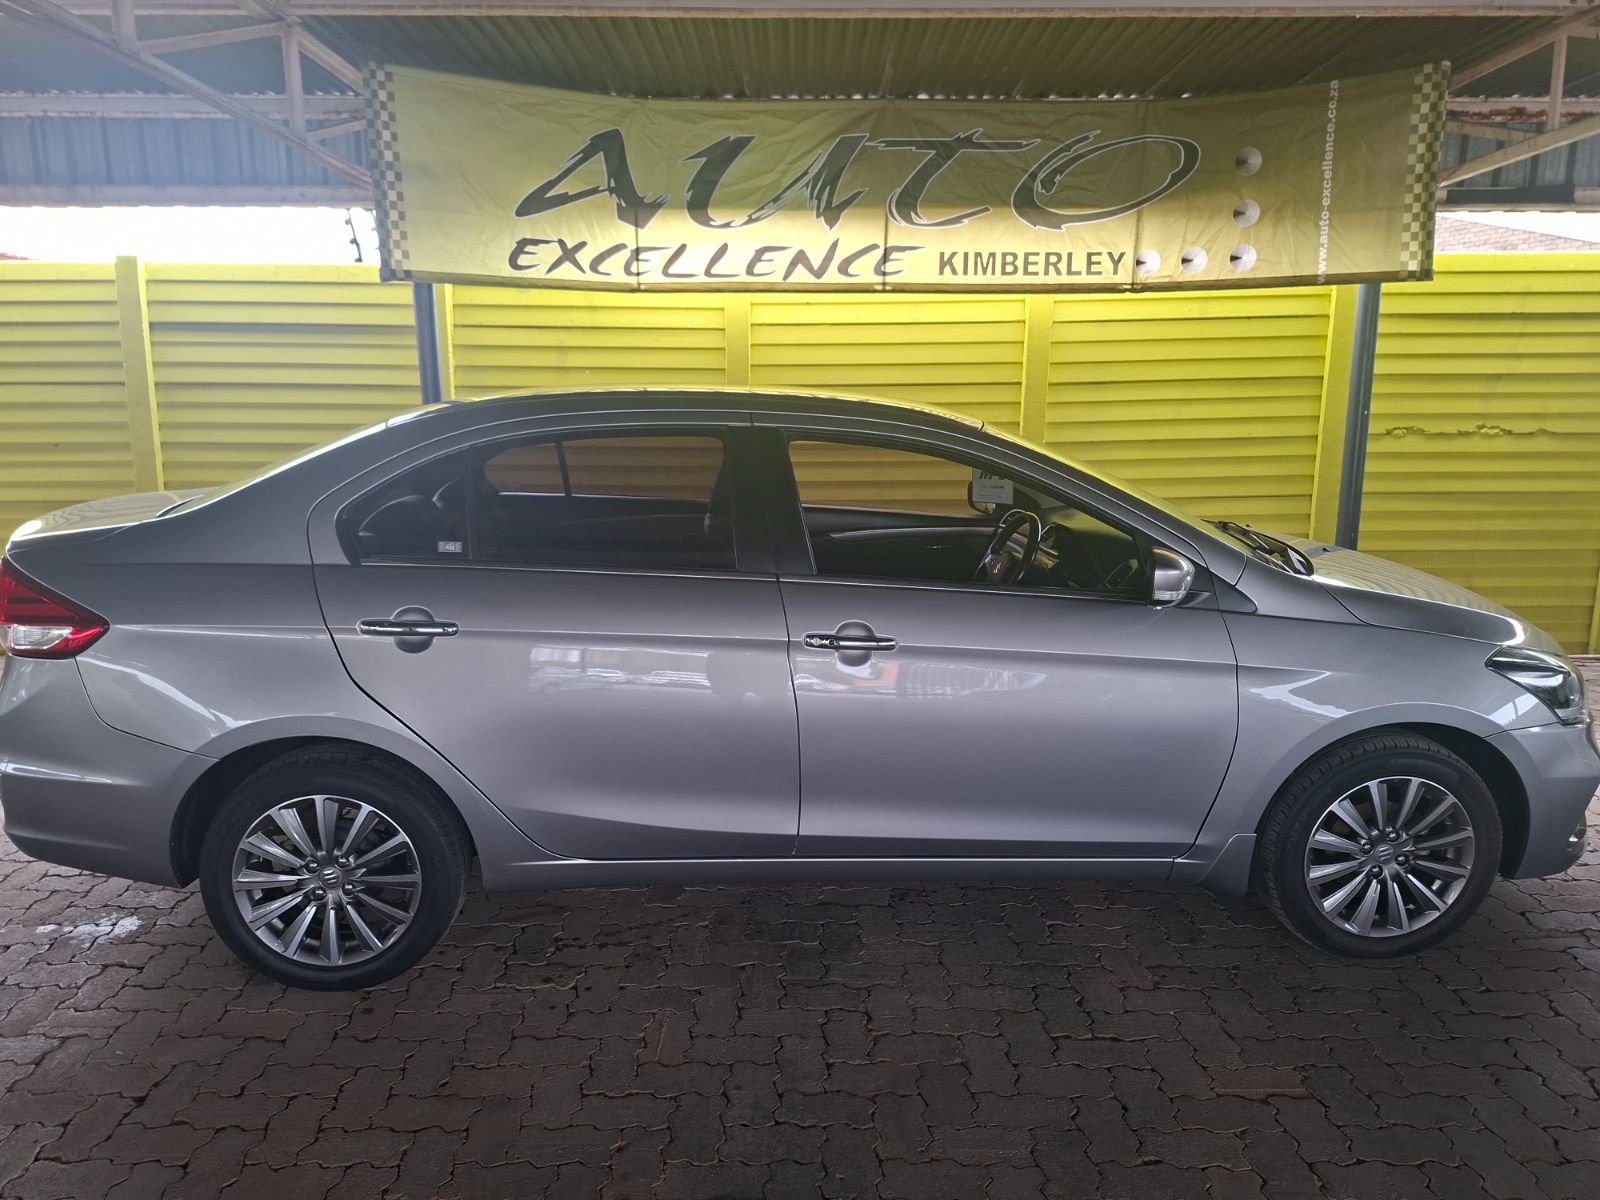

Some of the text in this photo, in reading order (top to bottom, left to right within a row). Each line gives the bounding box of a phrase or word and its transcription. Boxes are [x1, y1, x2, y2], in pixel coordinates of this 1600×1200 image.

[1317, 79, 1339, 284] www.auto-excellence.co.za
[508, 238, 1126, 282] EXCELLENCE KIMBERLEY
